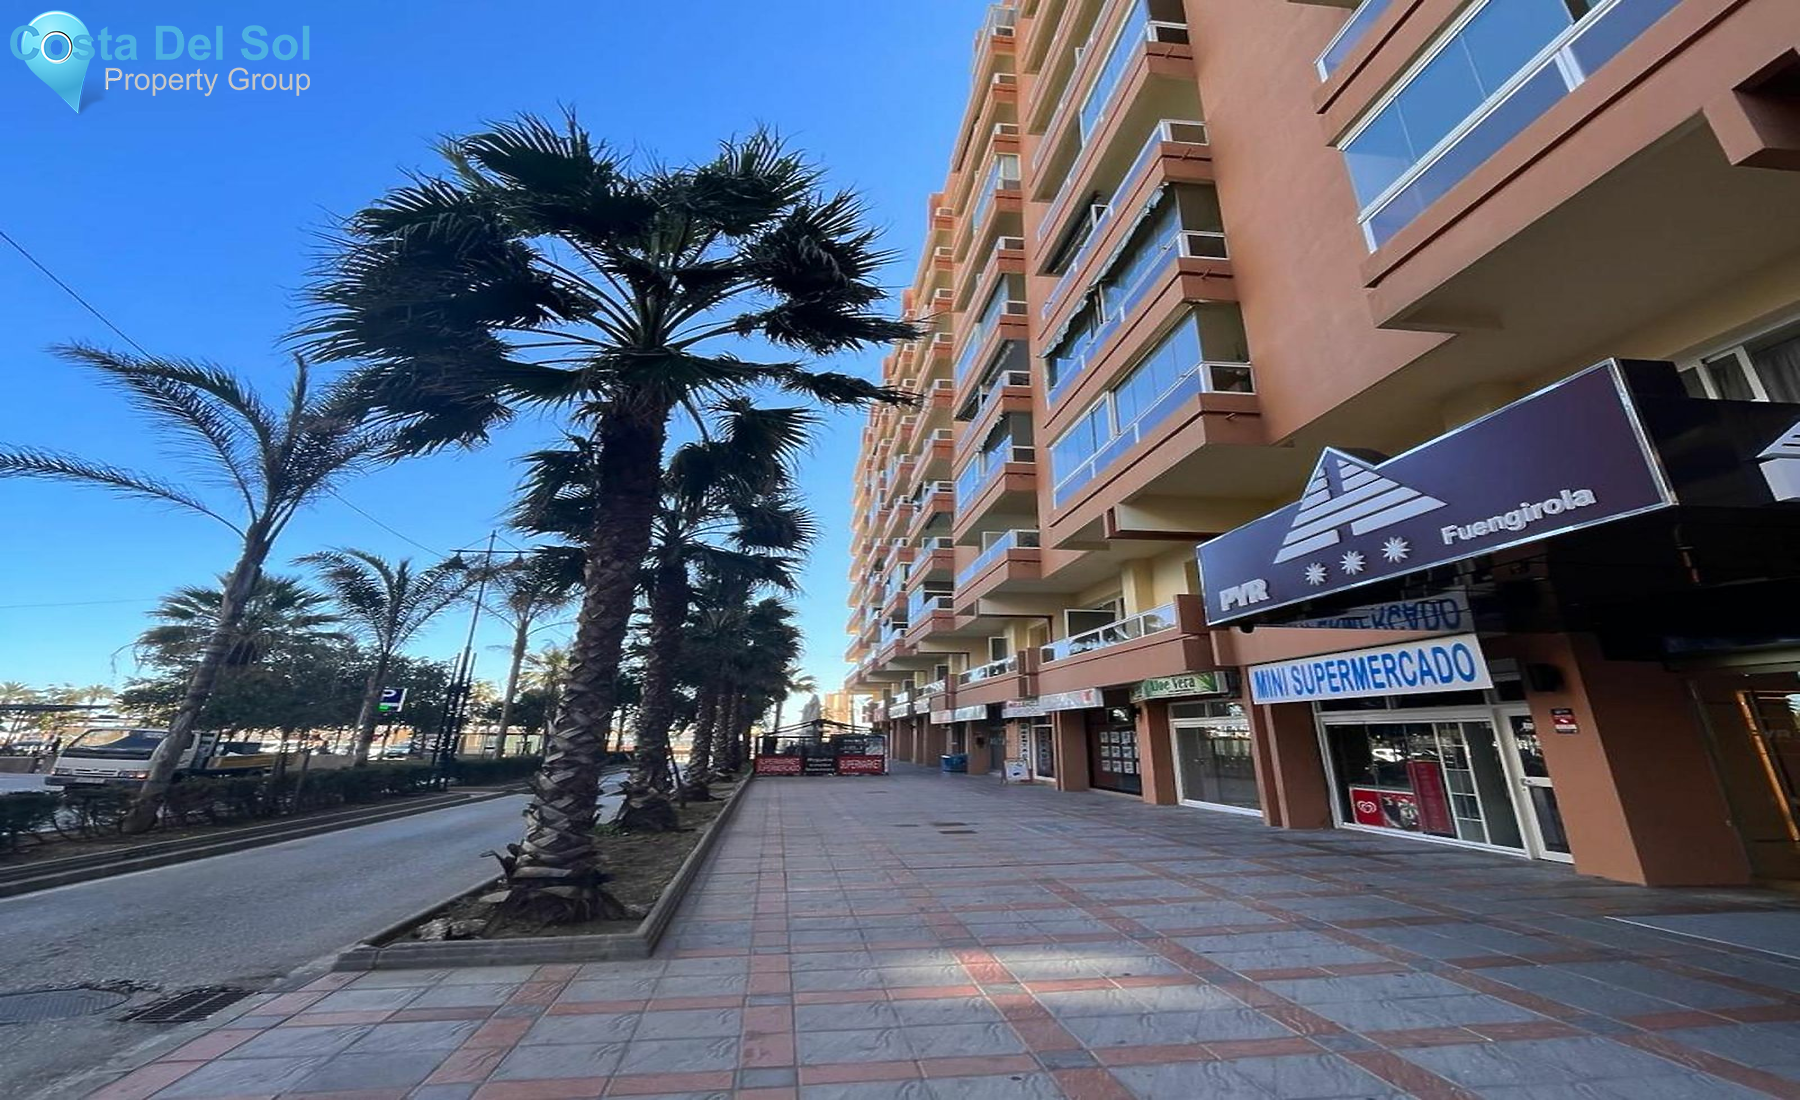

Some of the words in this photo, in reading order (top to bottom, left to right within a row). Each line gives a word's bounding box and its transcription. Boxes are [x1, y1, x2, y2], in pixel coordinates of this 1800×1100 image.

[1440, 489, 1597, 545] Fuengirola
[1219, 578, 1270, 612] PYR
[1171, 677, 1196, 689] Vera
[1253, 666, 1290, 699] MINI
[1291, 643, 1475, 695] SUPERMERCADO
